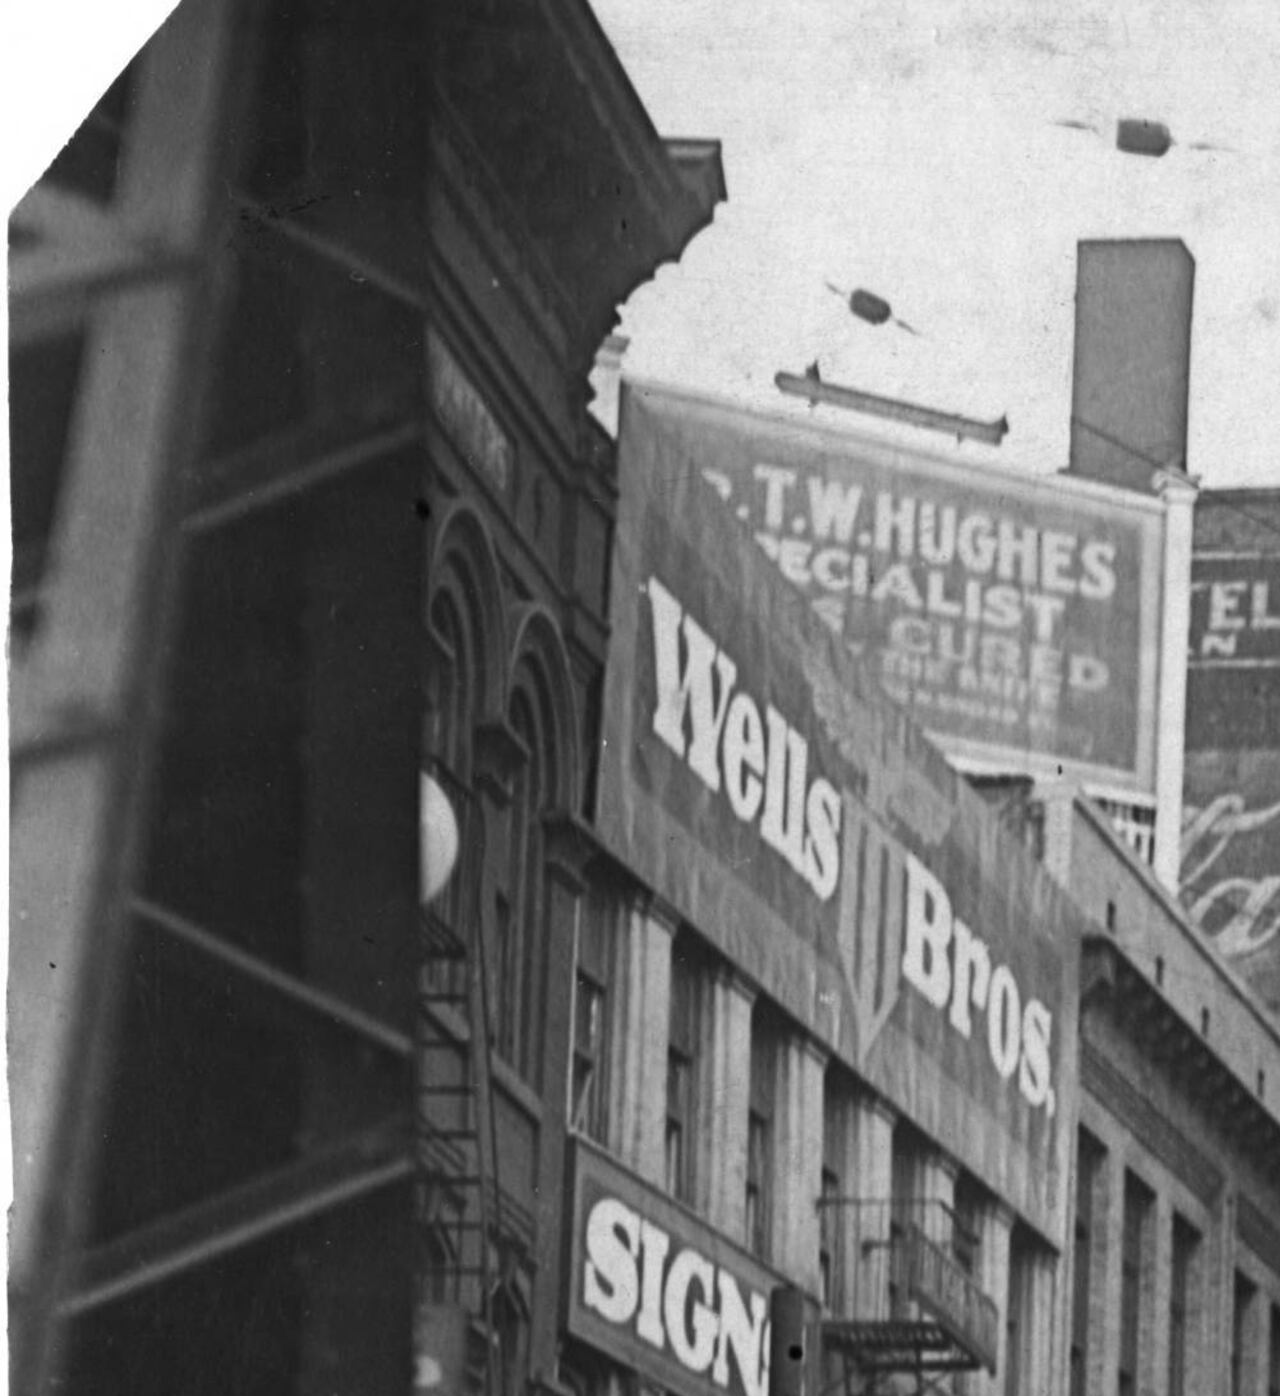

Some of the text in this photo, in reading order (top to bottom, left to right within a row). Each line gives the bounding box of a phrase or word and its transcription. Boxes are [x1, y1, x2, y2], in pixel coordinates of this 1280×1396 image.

[752, 530, 1066, 640] ECIALIST
[873, 488, 1117, 600] HUGHES
[648, 575, 843, 901] Wells
